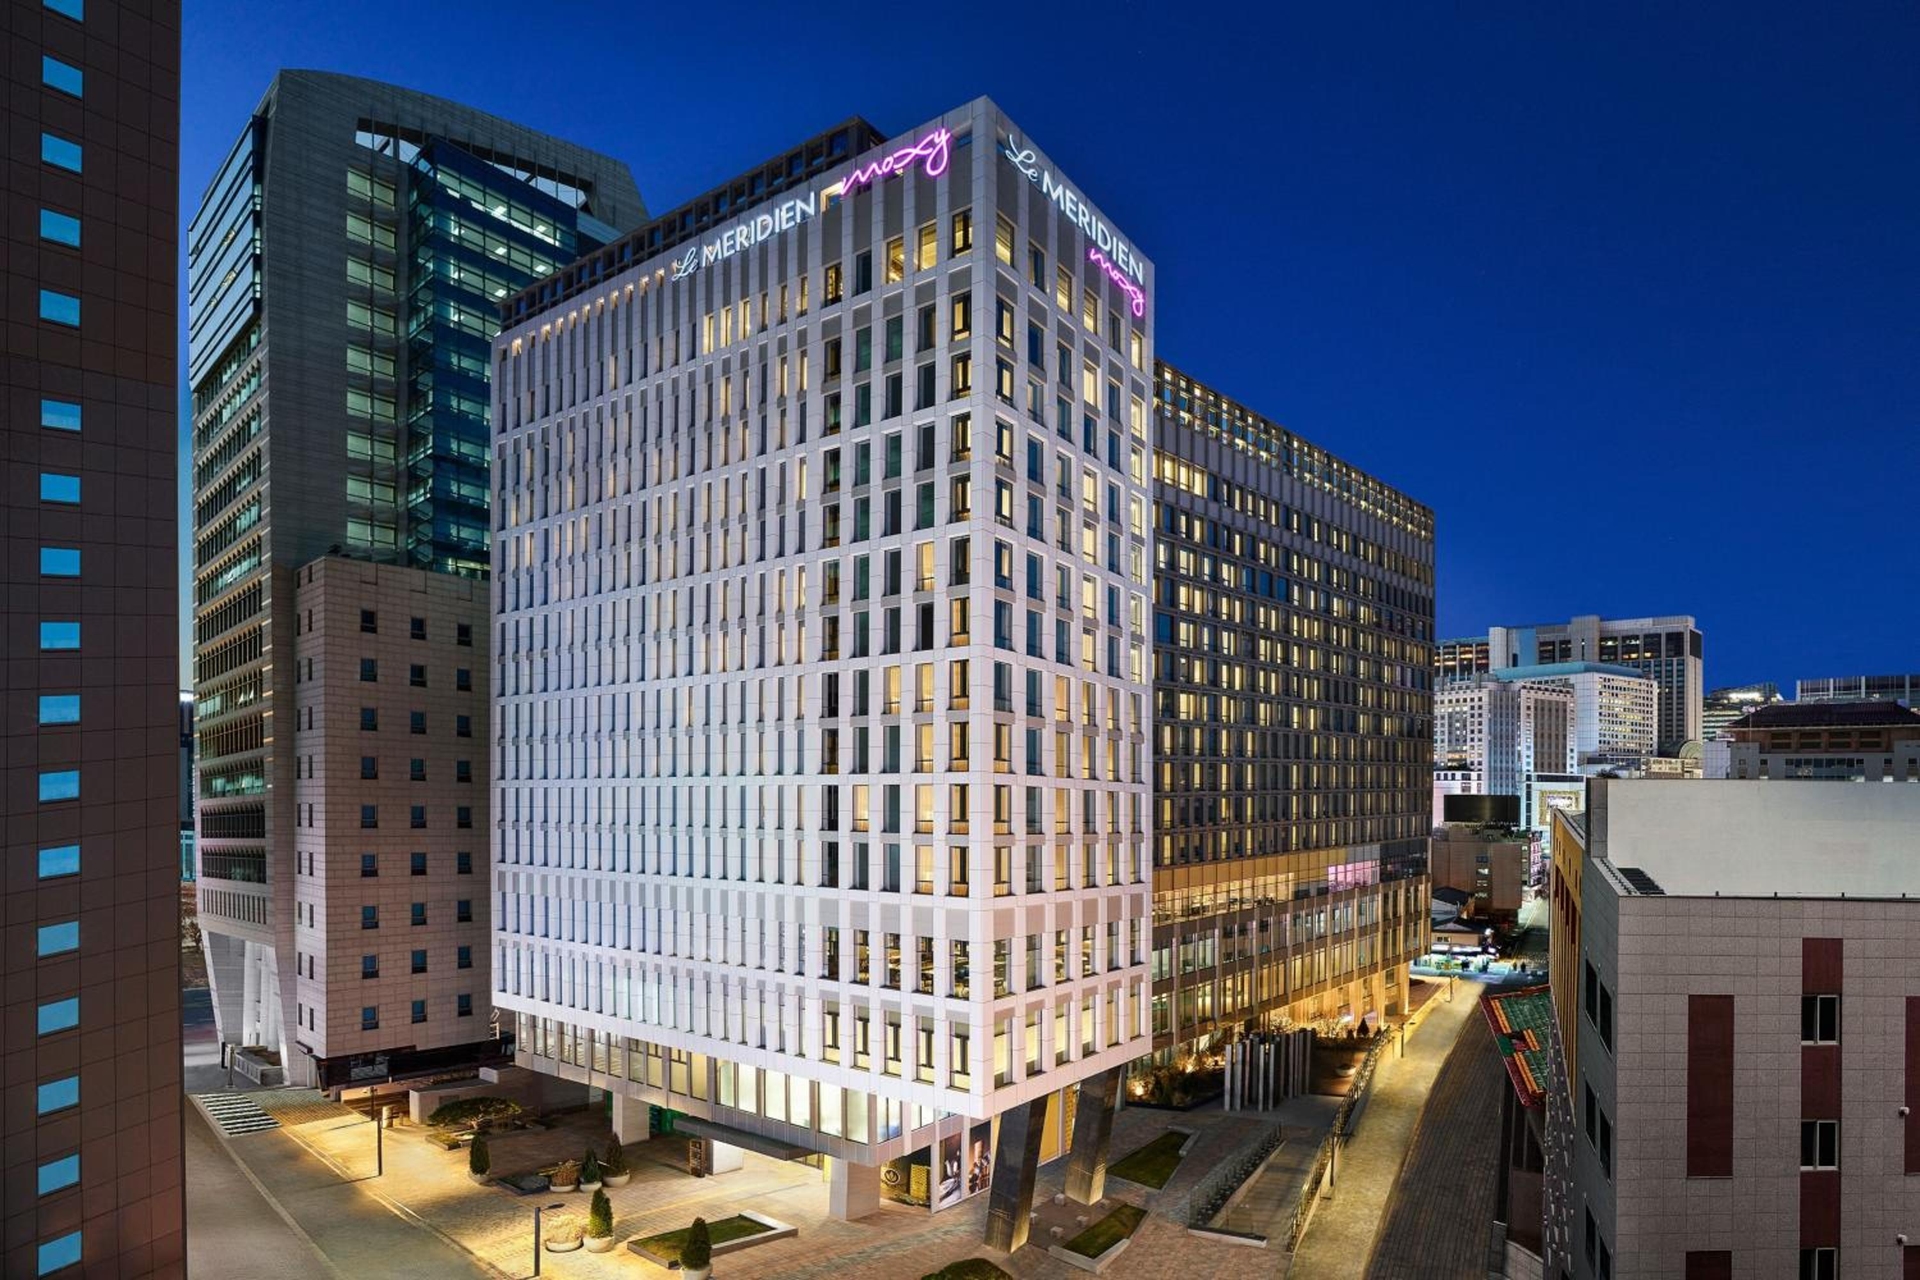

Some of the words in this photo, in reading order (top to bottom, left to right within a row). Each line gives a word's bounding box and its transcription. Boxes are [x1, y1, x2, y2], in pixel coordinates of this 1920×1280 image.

[840, 128, 951, 196] moxy
[671, 246, 699, 281] Le
[702, 191, 816, 268] MERIDIEN
[1005, 134, 1039, 182] Le
[1042, 170, 1145, 286] MERIDIEN
[1089, 248, 1146, 317] moxy
